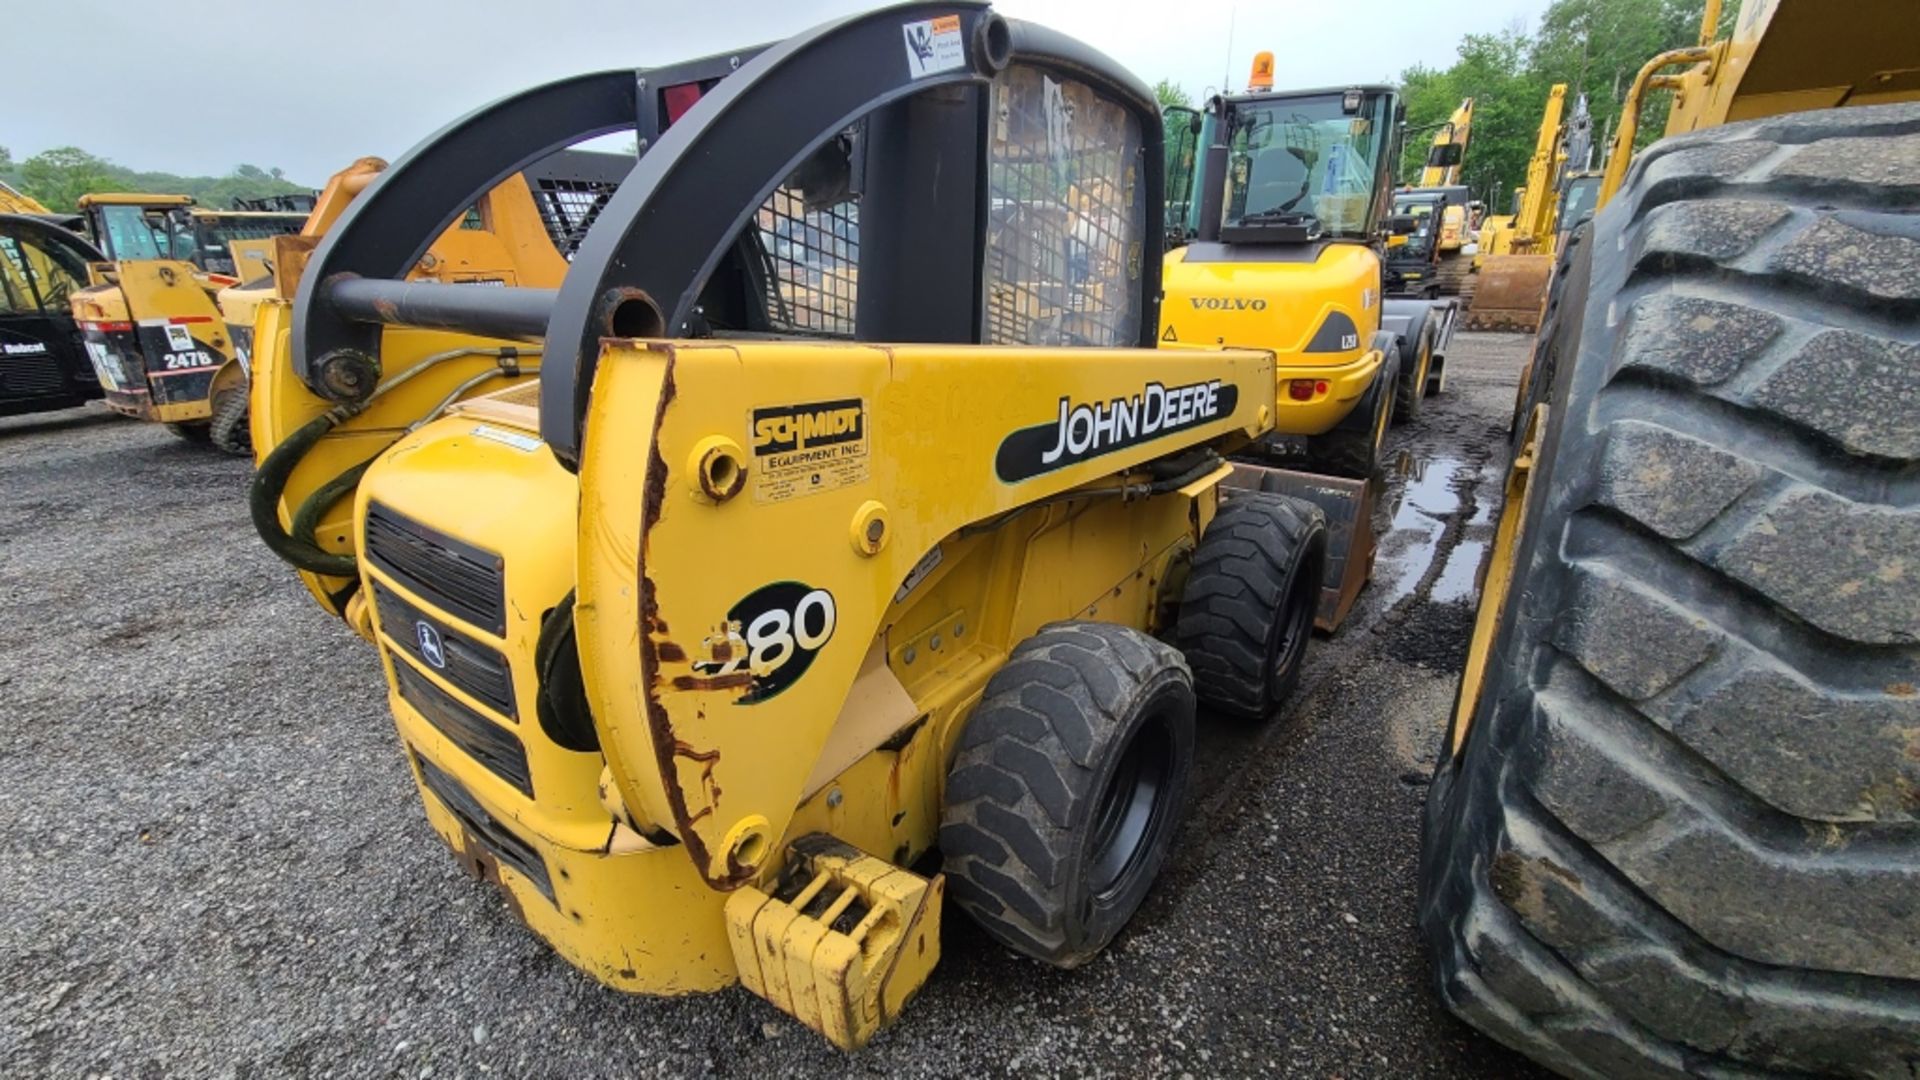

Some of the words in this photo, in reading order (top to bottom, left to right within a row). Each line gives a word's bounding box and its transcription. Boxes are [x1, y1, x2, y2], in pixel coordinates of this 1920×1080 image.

[1190, 297, 1266, 311] VOLVO
[163, 351, 213, 369] 247B
[752, 407, 861, 450] SCHMIDT
[1042, 397, 1139, 464] JOHN
[1142, 381, 1221, 434] DEERE
[769, 448, 837, 468] EQUIPMENT
